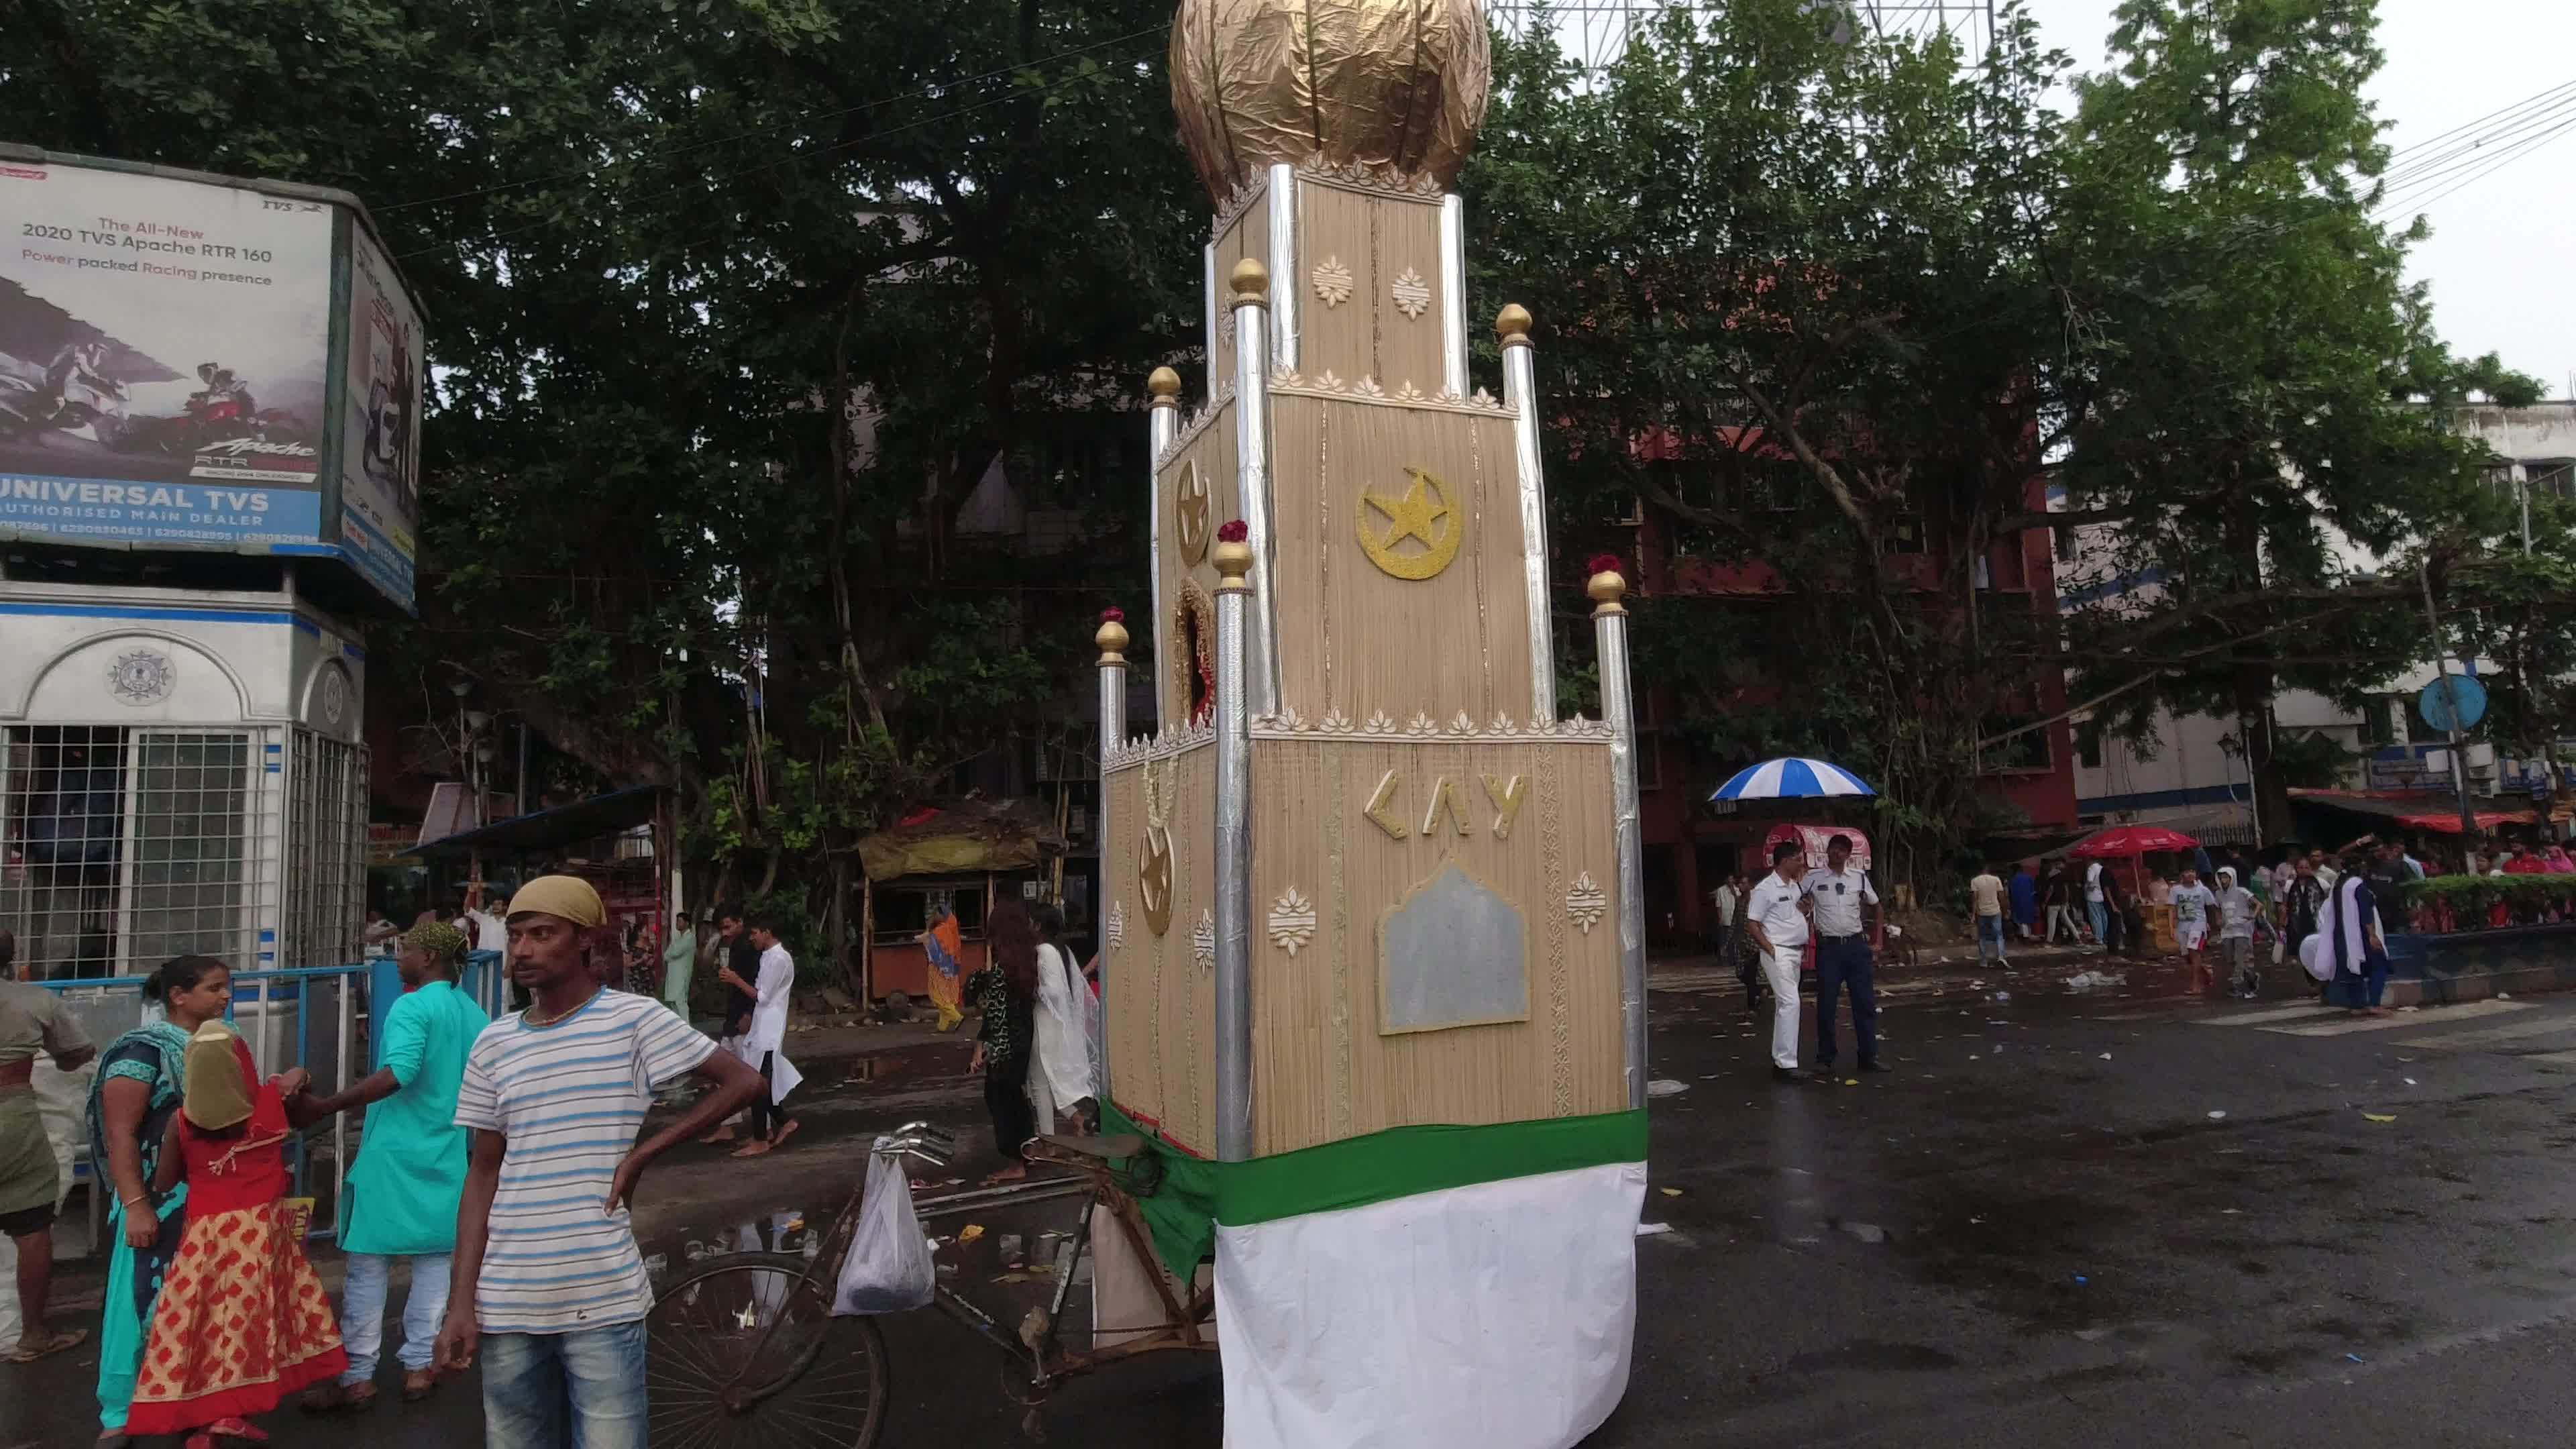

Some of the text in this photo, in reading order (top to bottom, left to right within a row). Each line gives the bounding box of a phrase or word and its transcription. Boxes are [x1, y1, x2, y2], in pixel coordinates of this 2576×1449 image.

[99, 217, 204, 239] The All-New
[22, 223, 272, 263] 2020 TVS Apache RTR 160
[22, 249, 272, 286] Power packed Racing presence
[195, 455, 248, 467] RTR
[205, 490, 268, 512] TVS
[0, 502, 263, 526] UTHORISED MAIN DEALER
